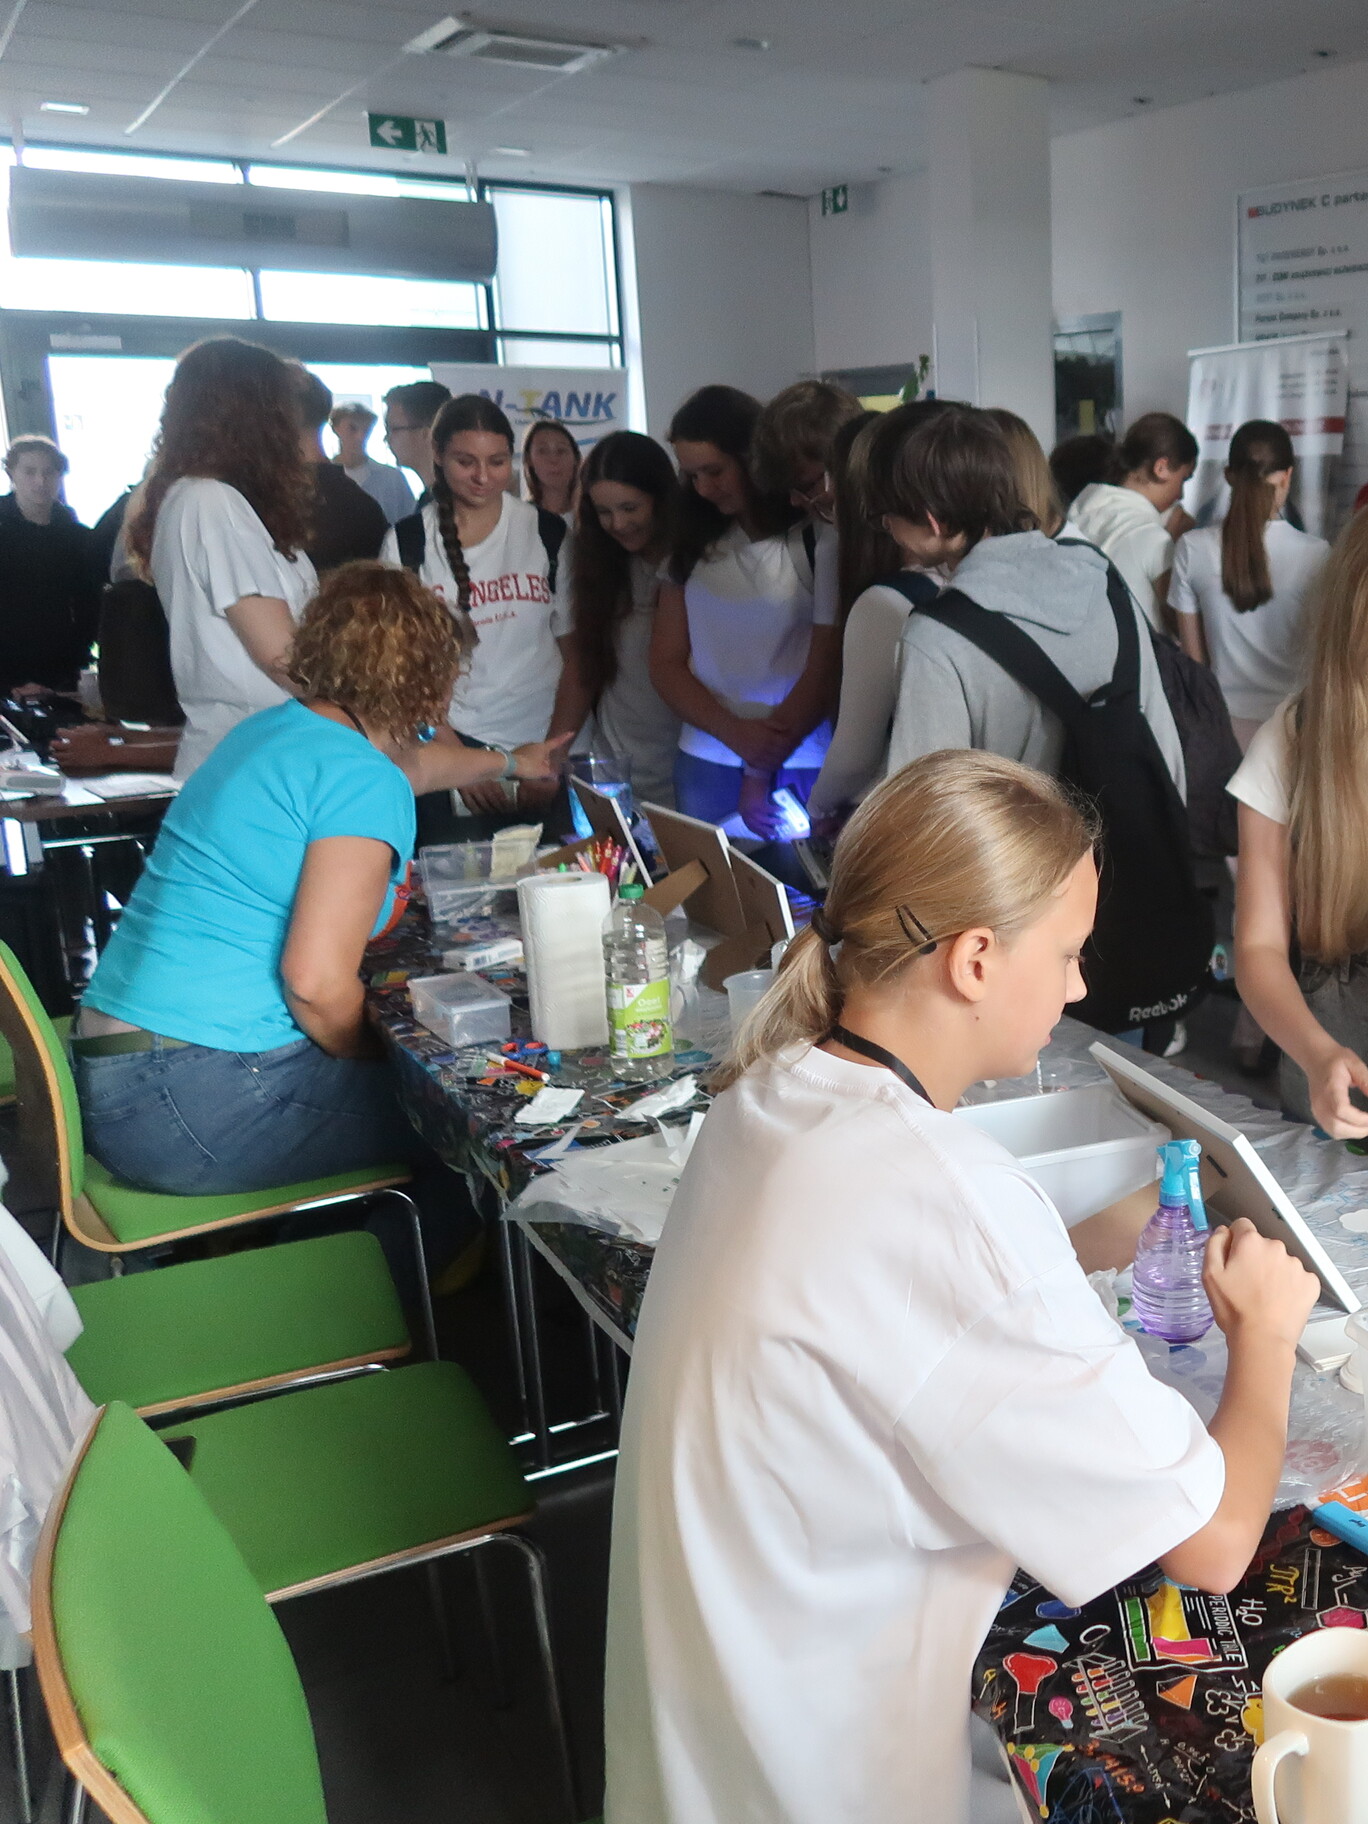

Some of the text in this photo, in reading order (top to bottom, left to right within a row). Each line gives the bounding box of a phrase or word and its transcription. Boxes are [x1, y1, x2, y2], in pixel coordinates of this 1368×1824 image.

[1258, 197, 1316, 217] BUDYNEK
[1321, 194, 1330, 207] C
[468, 572, 552, 608] NGELES
[1128, 993, 1188, 1022] Reebok
[1207, 1594, 1233, 1637] PERIODIC
